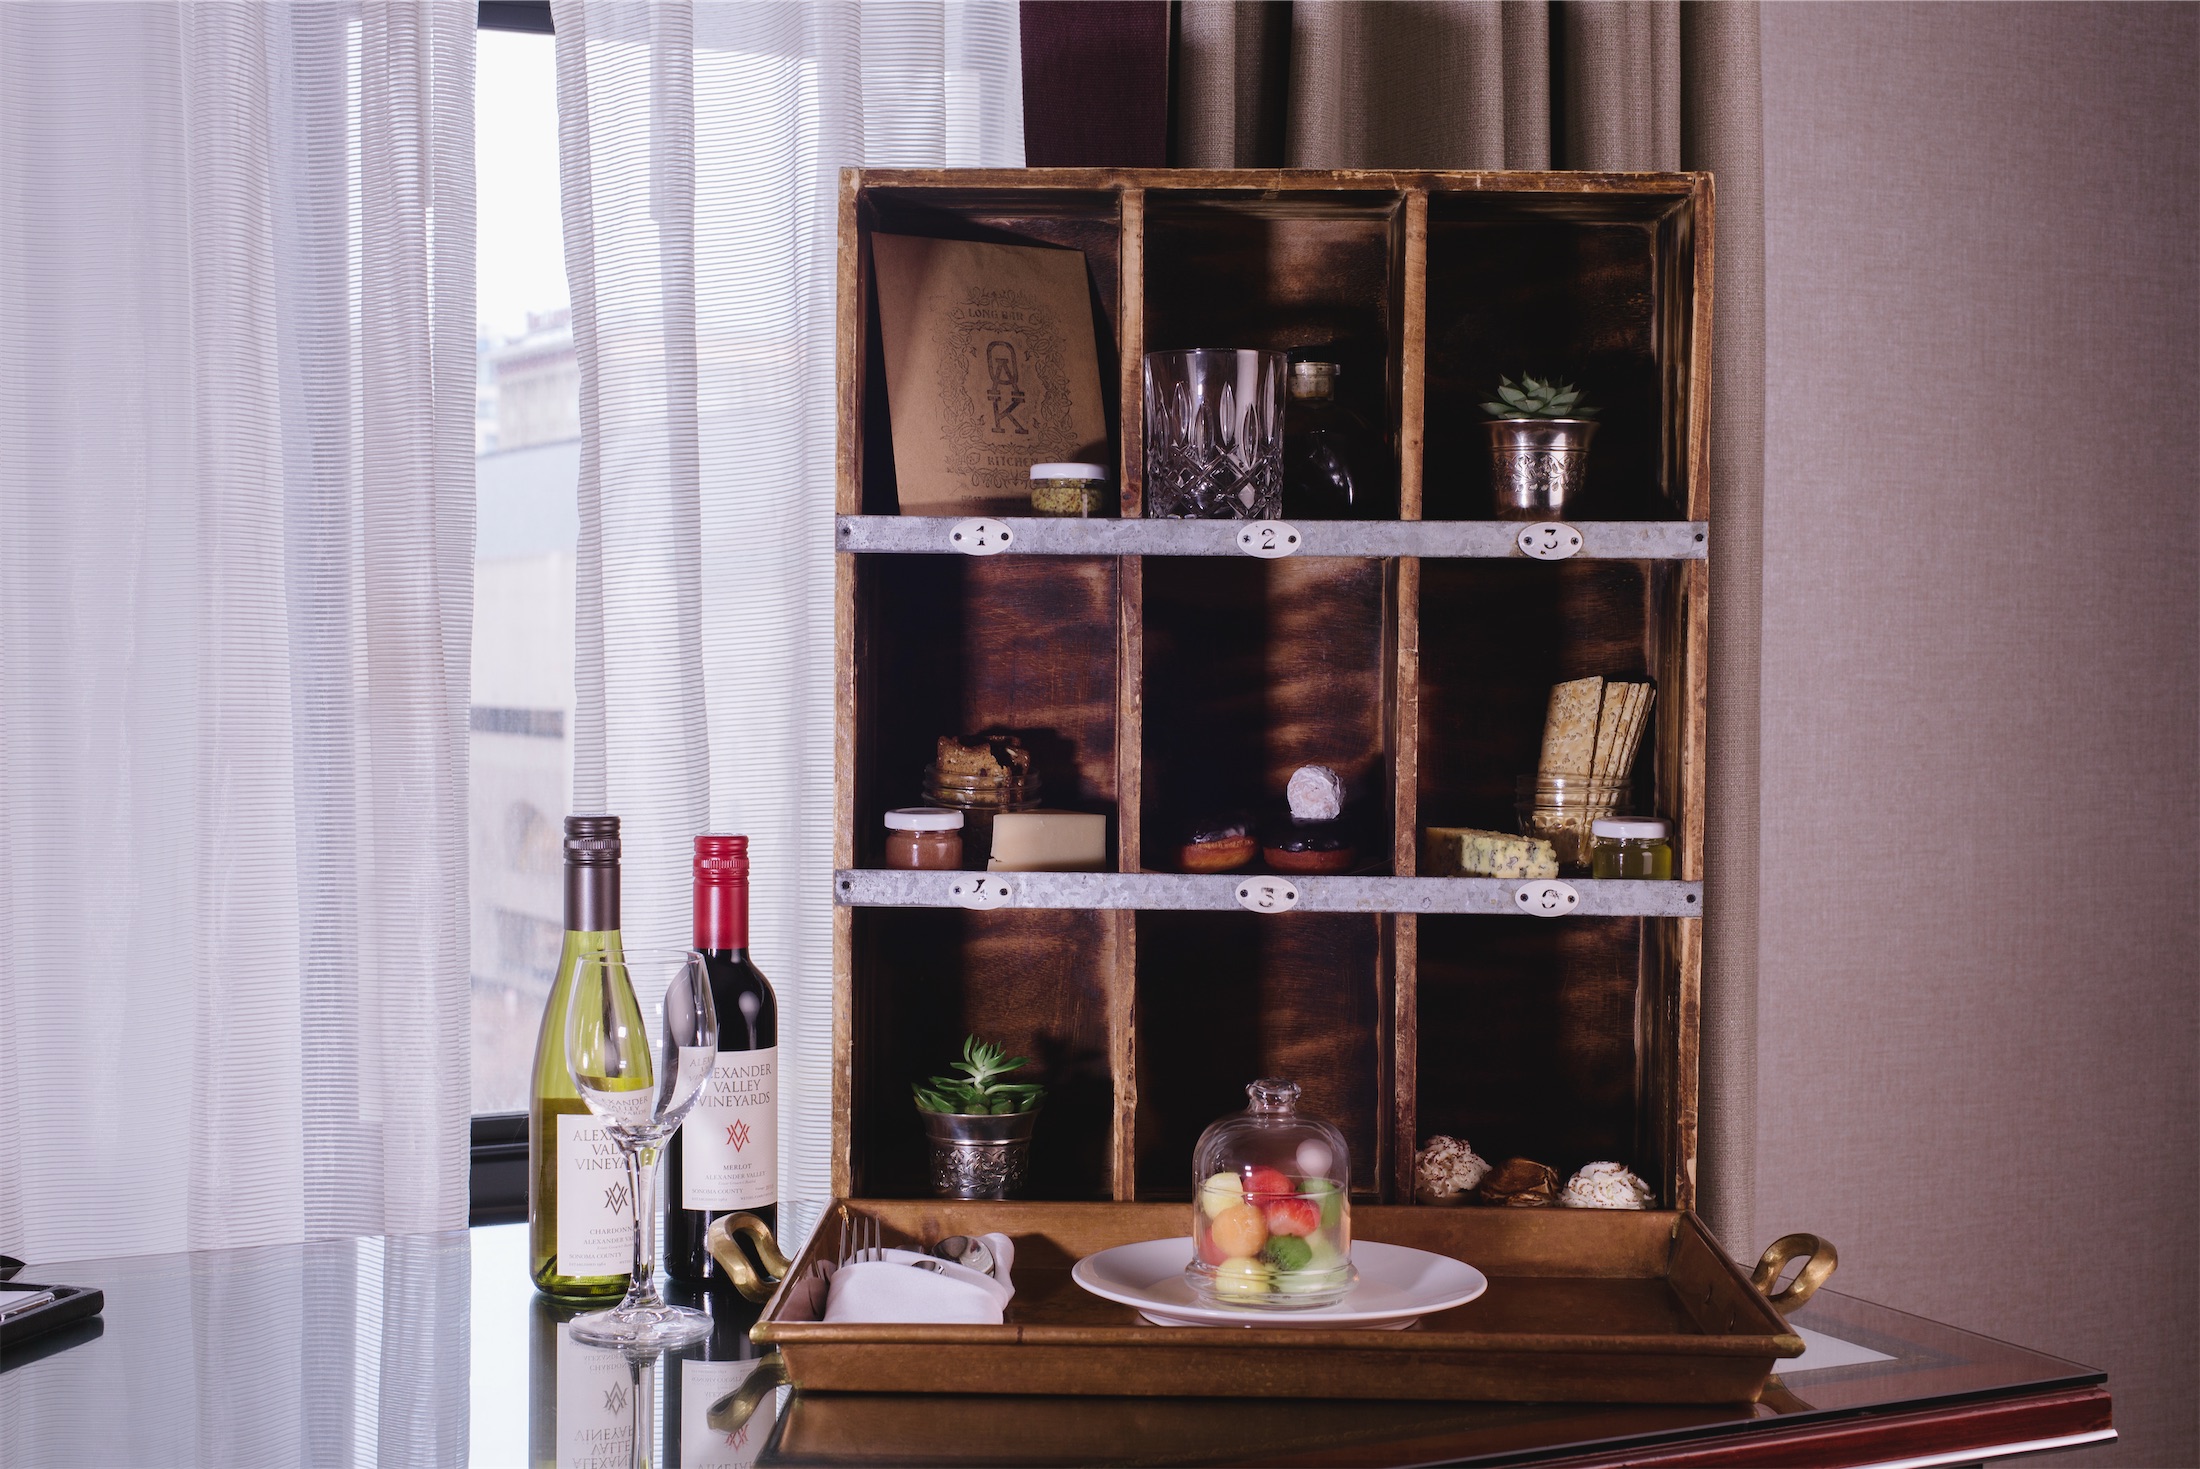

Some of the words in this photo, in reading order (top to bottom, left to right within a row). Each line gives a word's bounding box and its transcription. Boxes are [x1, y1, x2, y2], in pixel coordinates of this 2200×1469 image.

[968, 308, 999, 319] LONG
[1001, 310, 1024, 321] BAR
[987, 456, 1039, 468] KITCHEN
[1261, 528, 1276, 550] 2
[711, 1063, 772, 1079] EXANDER
[713, 1079, 761, 1093] VALLEY
[700, 1091, 770, 1108] VINEYARDS
[592, 1143, 619, 1156] VAL
[723, 1163, 752, 1171] MERLOT
[705, 1173, 746, 1181] ALEXANDER
[589, 1225, 634, 1235] CHARDONN
[583, 1236, 624, 1246] ALEXANDER
[596, 1251, 622, 1259] COUNTY
